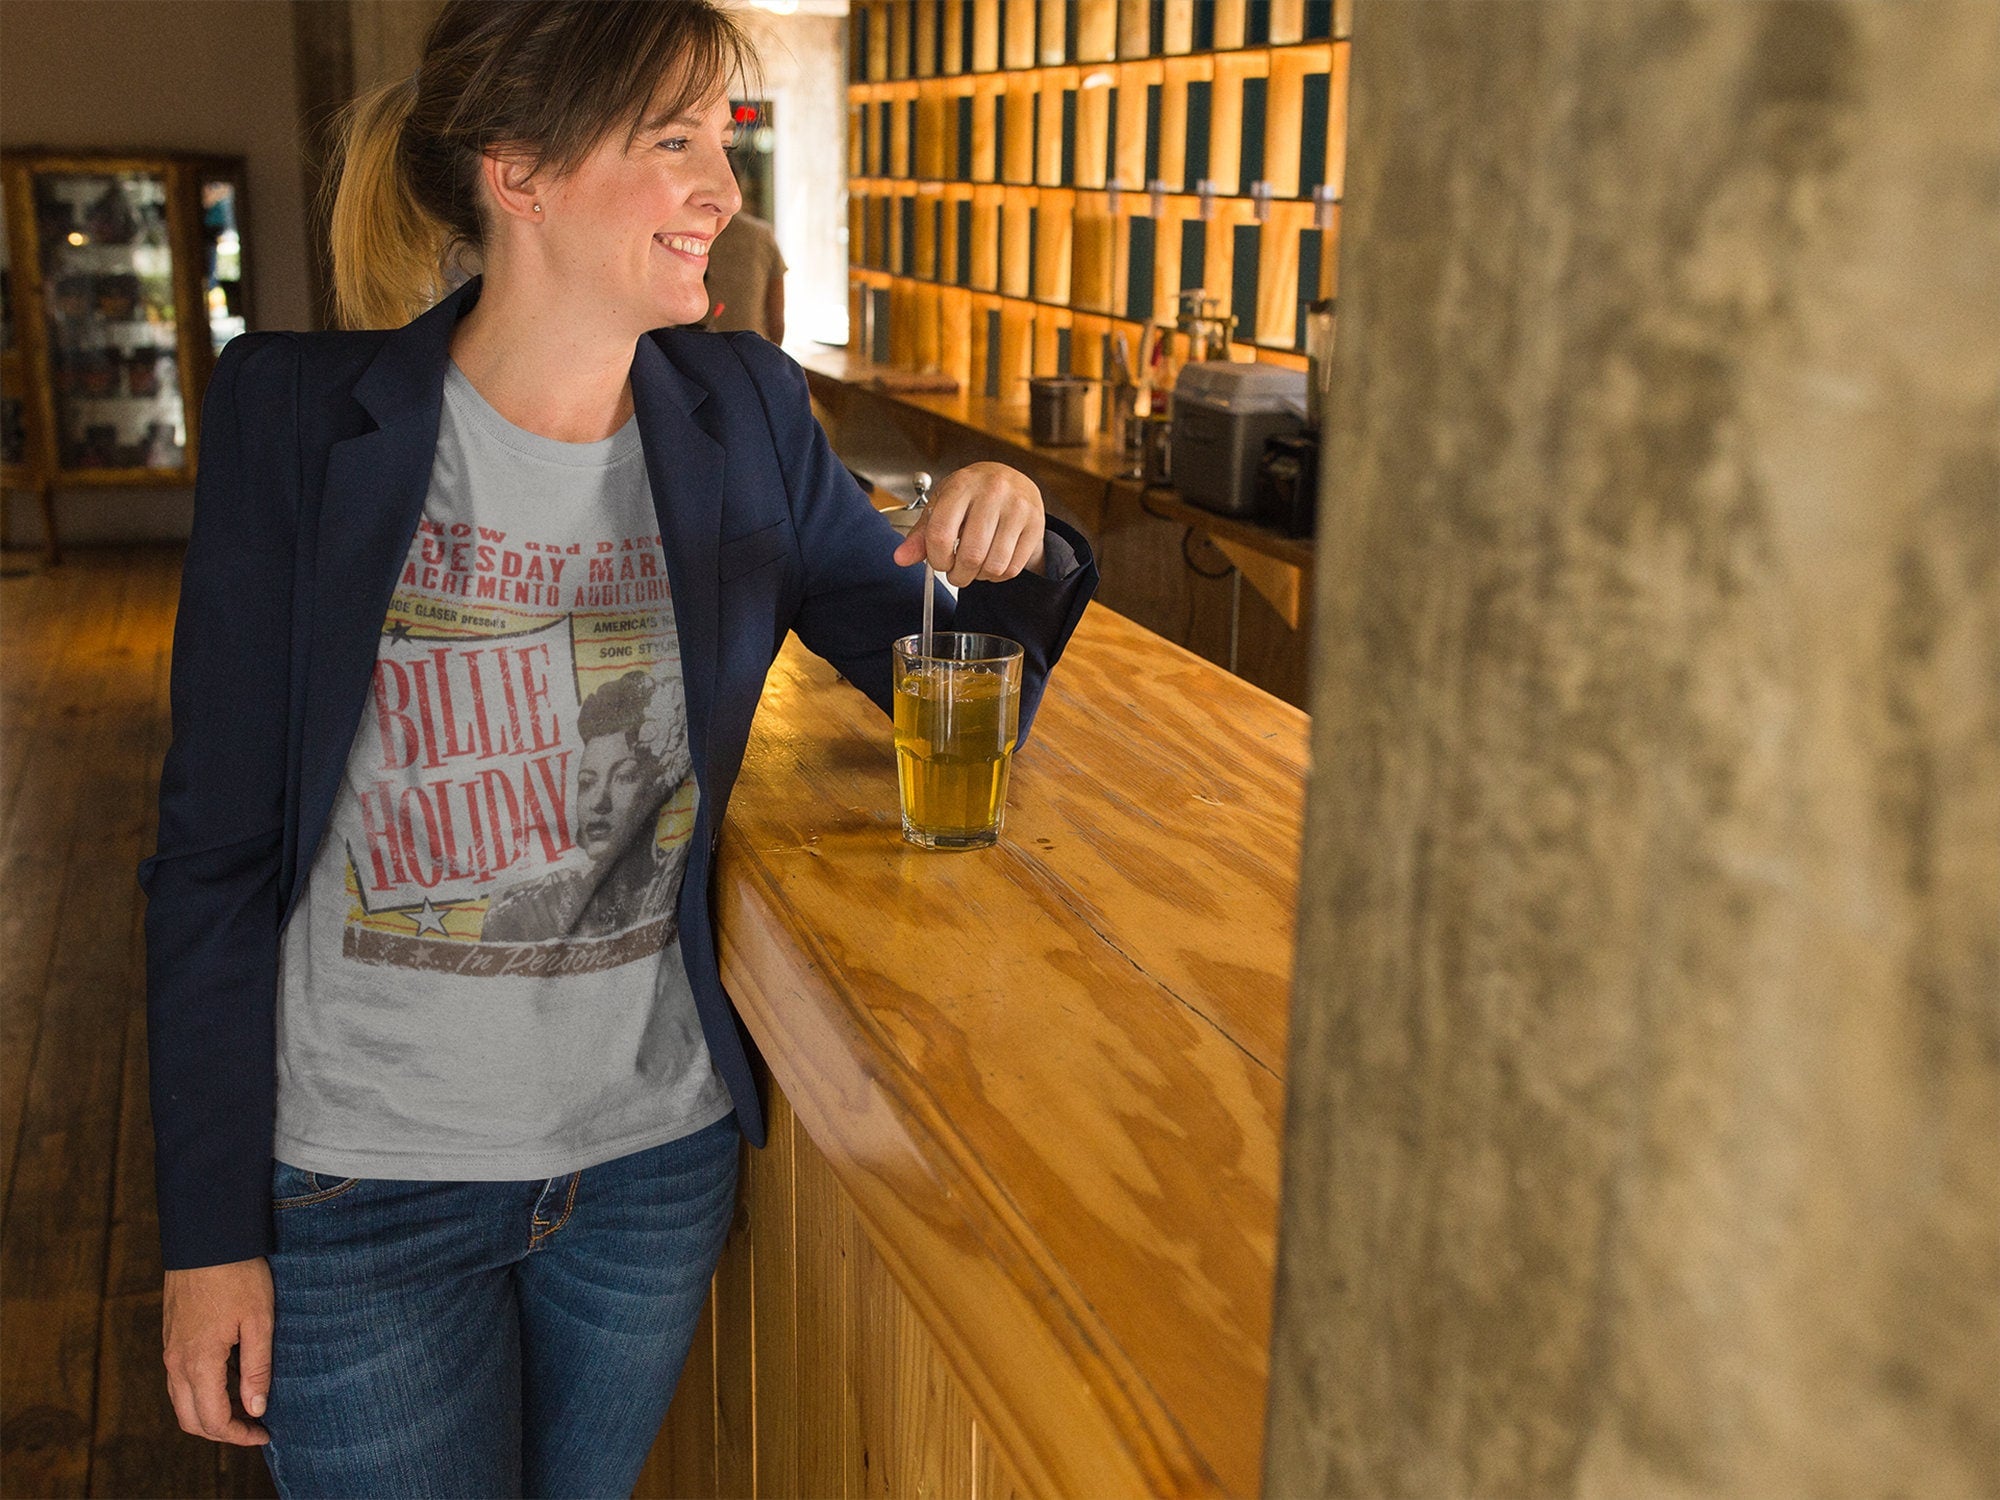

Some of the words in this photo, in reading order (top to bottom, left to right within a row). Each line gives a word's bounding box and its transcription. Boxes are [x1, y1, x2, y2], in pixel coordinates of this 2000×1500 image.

[412, 534, 566, 583] UESDAY
[525, 541, 581, 555] and
[402, 562, 560, 607] ACREMENTO
[415, 604, 457, 622] GLASER
[594, 616, 658, 633] AMERICA'S
[599, 645, 633, 659] SONG
[372, 643, 562, 771] BILLIE
[358, 750, 577, 892] HOLIDAY
[455, 946, 495, 974] In
[500, 944, 611, 974] Person
